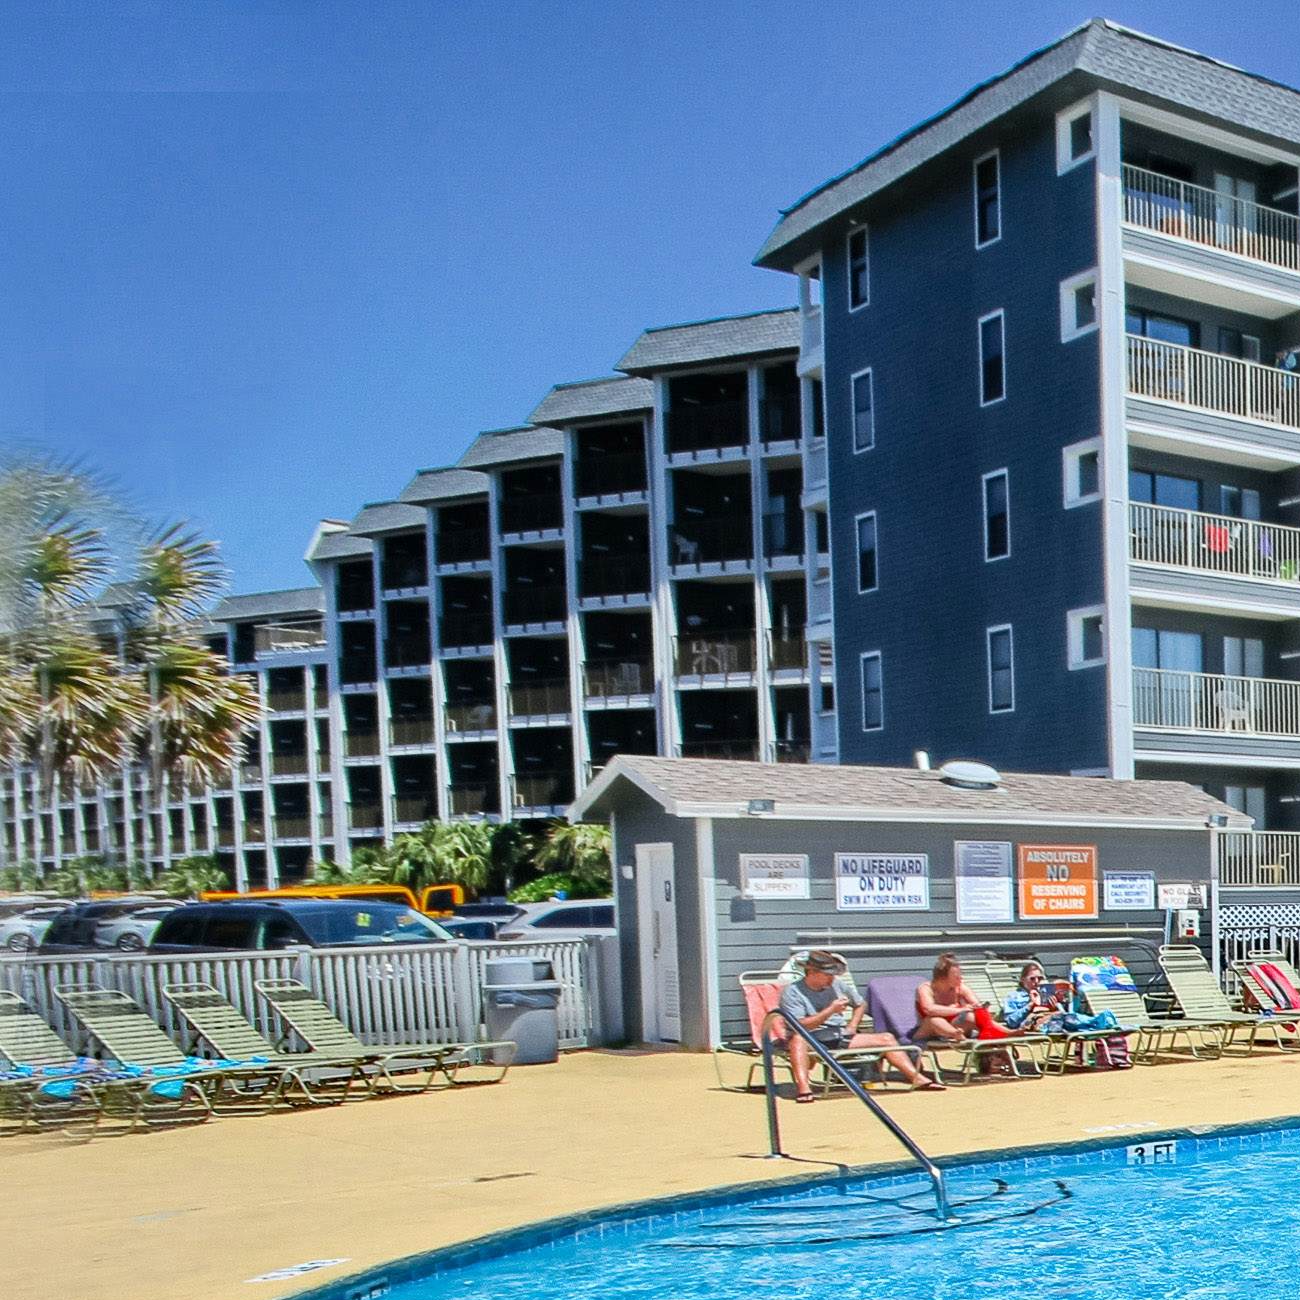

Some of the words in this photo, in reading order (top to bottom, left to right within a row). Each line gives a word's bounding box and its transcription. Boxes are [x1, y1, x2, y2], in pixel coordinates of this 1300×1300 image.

[1027, 851, 1089, 863] ABSOLUTELY
[749, 859, 772, 869] POOL
[773, 860, 801, 869] DECKS
[842, 859, 858, 874] NO
[861, 859, 922, 875] LIFEGUARD
[767, 871, 783, 879] ARE
[1046, 864, 1070, 882] NO
[859, 877, 874, 891] ON
[878, 876, 906, 891] DUTY
[1031, 885, 1087, 896] RESERVING
[843, 895, 862, 905] SWIM
[863, 895, 872, 904] AT
[873, 895, 890, 904] YOUR
[891, 895, 906, 904] OWN
[908, 895, 922, 904] RISK
[1033, 898, 1047, 910] OF
[1049, 898, 1086, 910] CHAIRS
[1134, 1146, 1146, 1164] 3
[1153, 1143, 1174, 1163] FT
